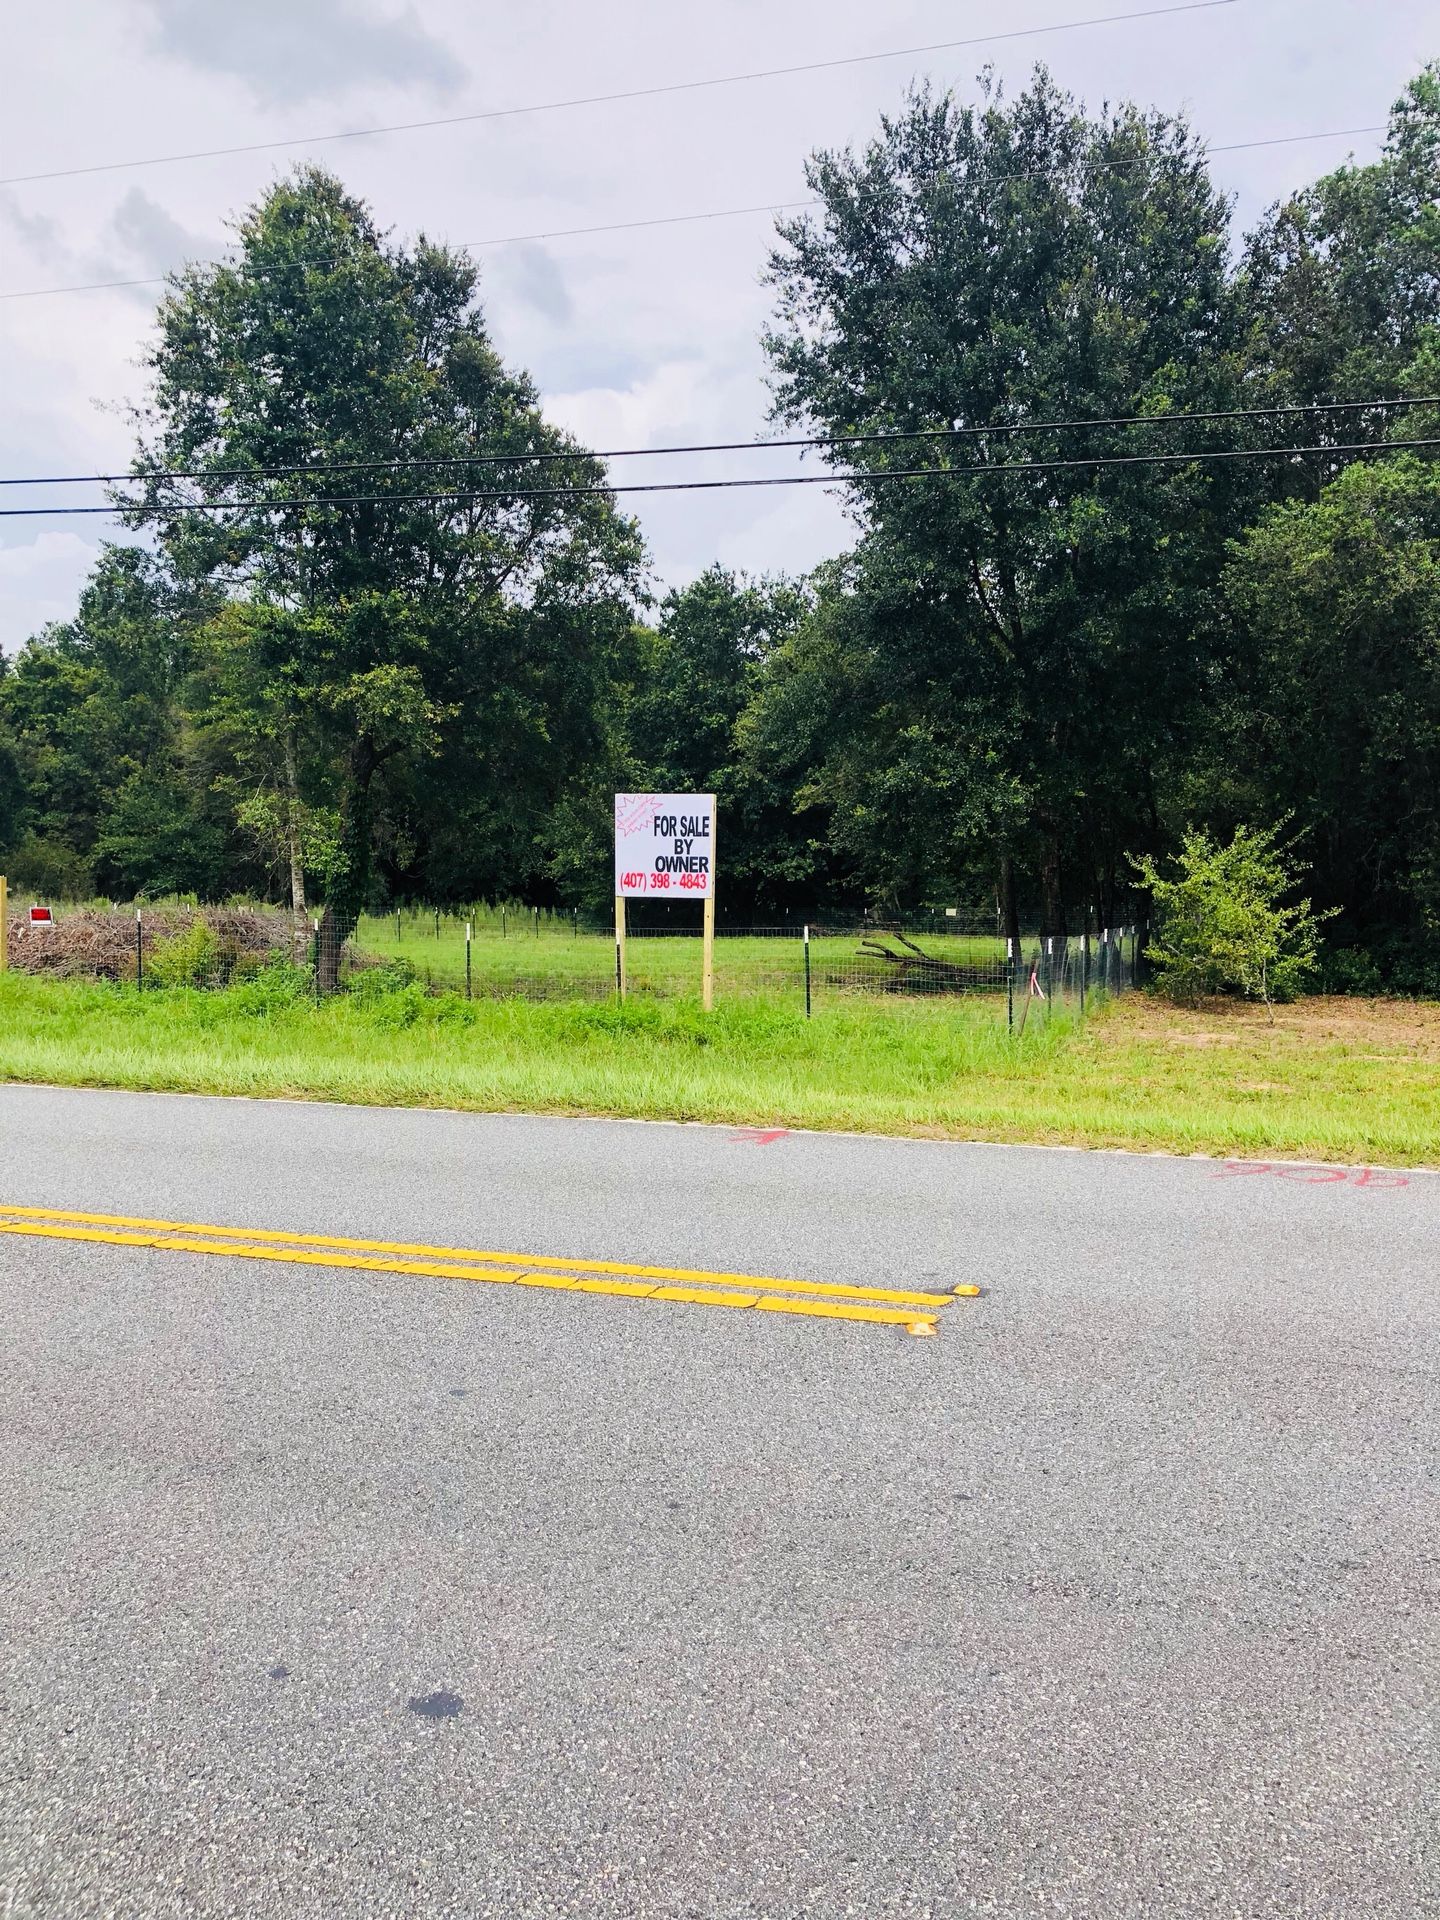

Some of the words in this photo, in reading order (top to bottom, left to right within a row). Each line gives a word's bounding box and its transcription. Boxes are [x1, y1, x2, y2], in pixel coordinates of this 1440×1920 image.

[653, 815, 677, 837] FOR
[680, 815, 710, 837] SALE
[674, 839, 694, 855] BY
[655, 855, 709, 873] OWNER
[620, 872, 647, 892] (407)
[650, 873, 670, 889] 398
[679, 873, 707, 890] 4843
